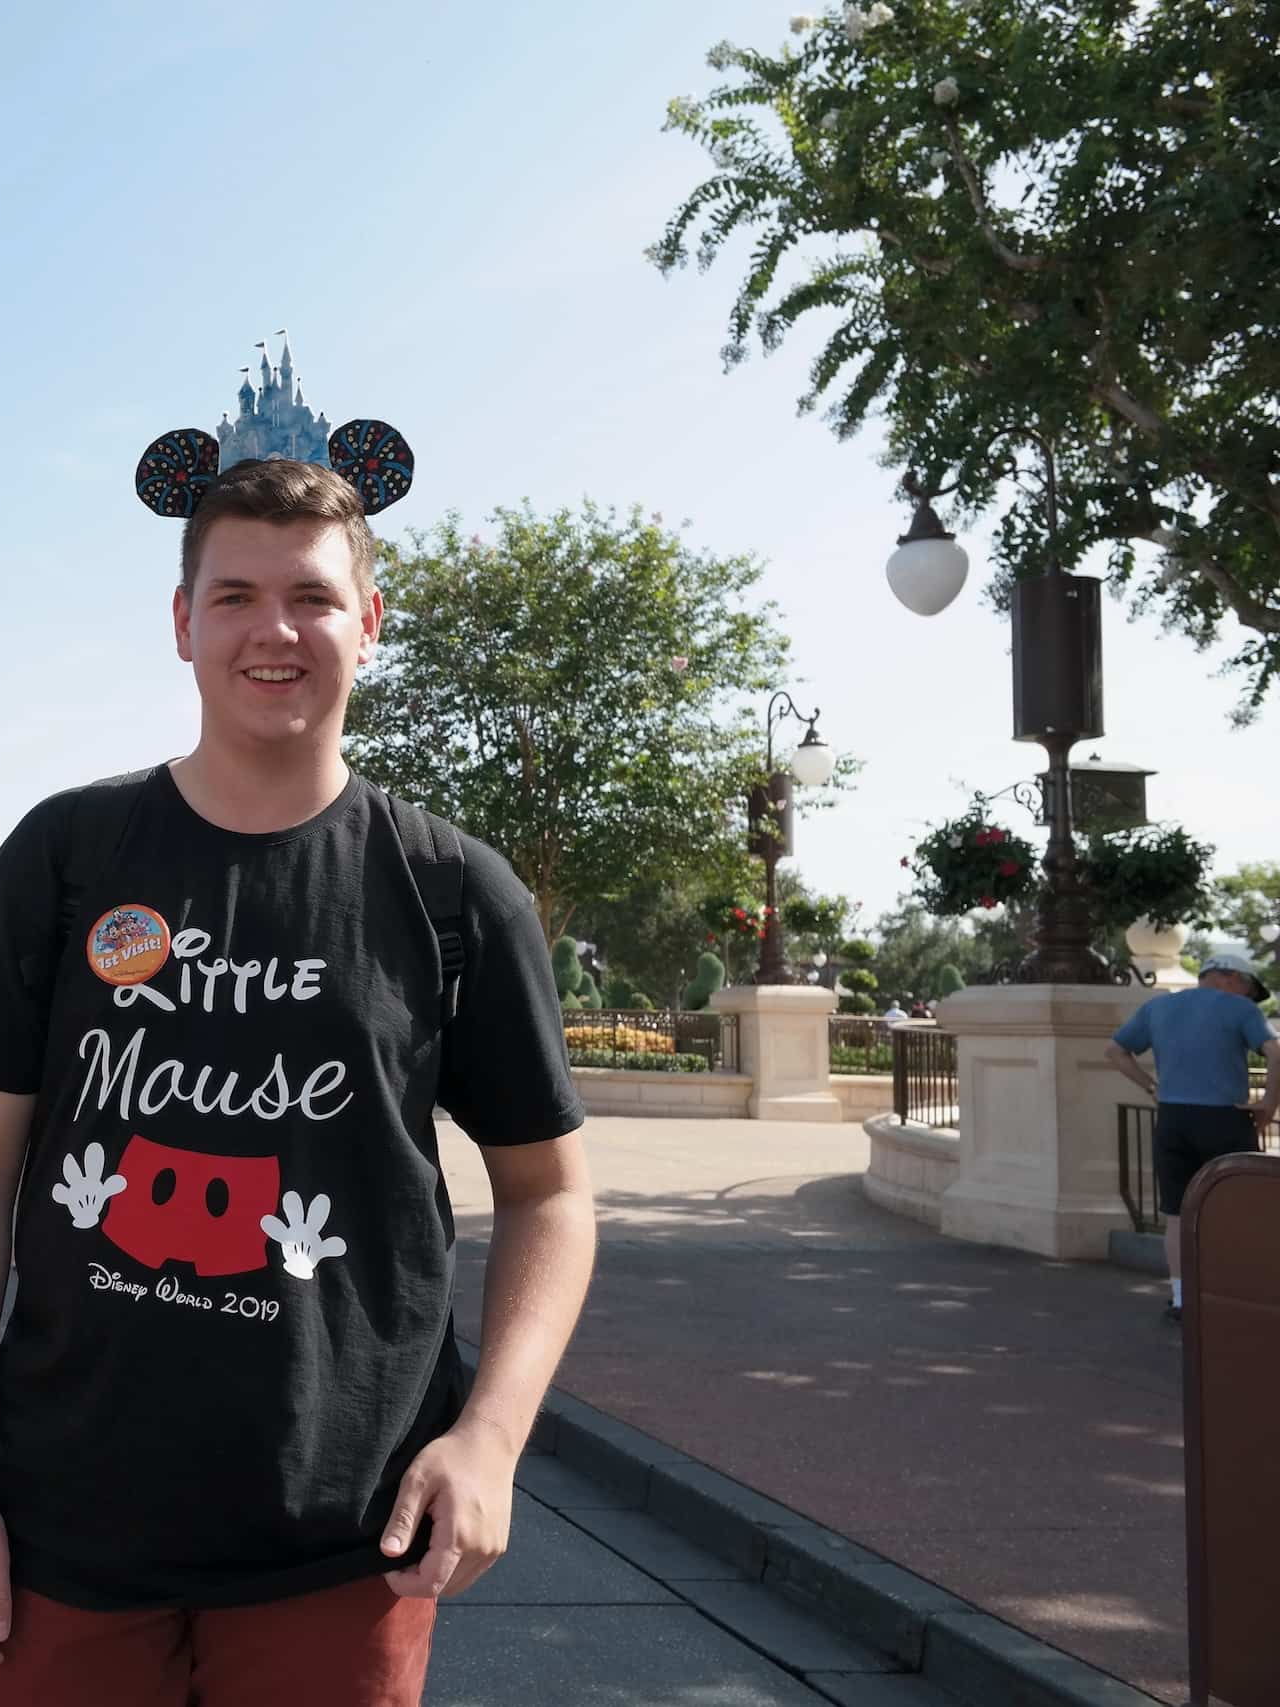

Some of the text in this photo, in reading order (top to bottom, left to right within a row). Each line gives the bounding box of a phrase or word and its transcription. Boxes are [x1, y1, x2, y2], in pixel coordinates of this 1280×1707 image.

[97, 938, 162, 969] 1st Visit!
[73, 1027, 354, 1122] Mouse
[220, 1292, 280, 1322] 2019
